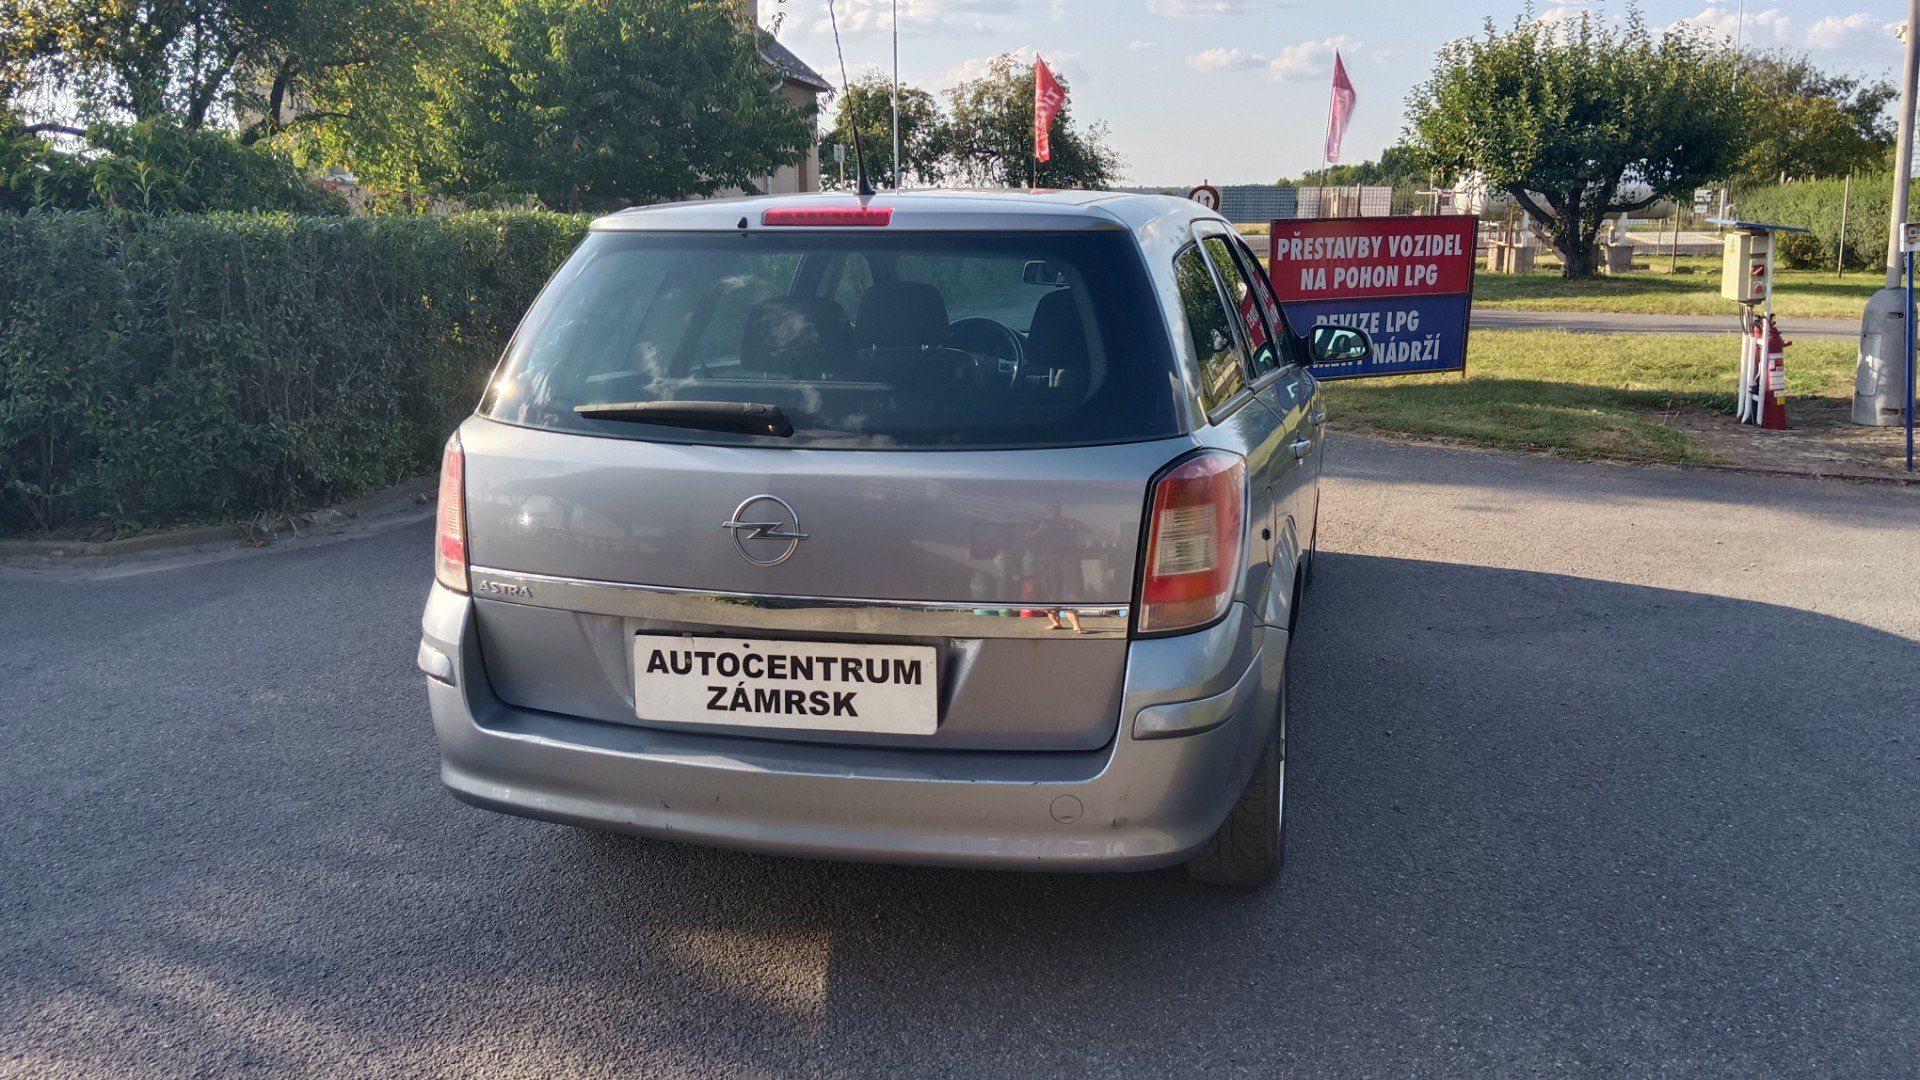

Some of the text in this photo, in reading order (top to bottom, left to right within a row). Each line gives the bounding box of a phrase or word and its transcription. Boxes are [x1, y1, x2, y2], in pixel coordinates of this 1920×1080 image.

[1276, 230, 1462, 261] PŘESTAVBY VOZIDEL
[1300, 263, 1438, 291] NA POHON LPG
[1385, 309, 1420, 333] LPG
[1372, 332, 1440, 364] NÁDRŽÍ
[480, 580, 533, 598] ASTRA
[646, 649, 922, 685] AUTOCENTRUM
[706, 681, 859, 717] ZÁMRSK
